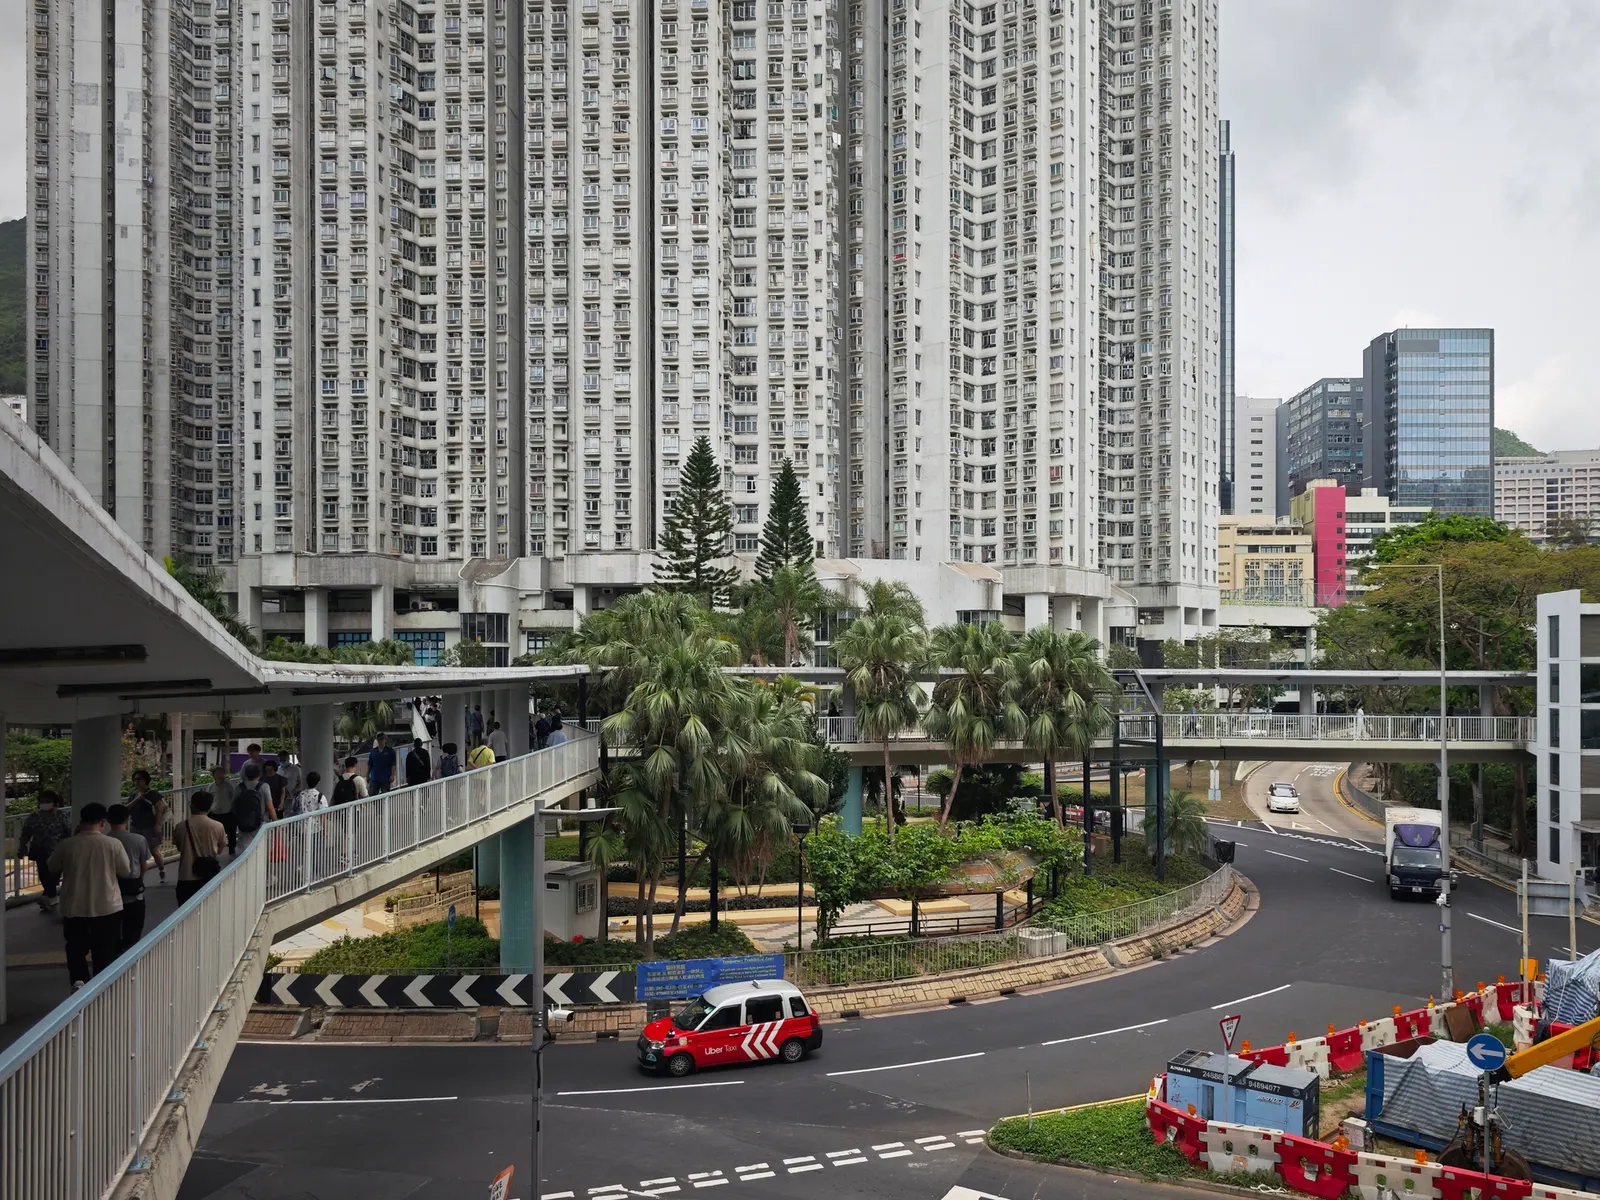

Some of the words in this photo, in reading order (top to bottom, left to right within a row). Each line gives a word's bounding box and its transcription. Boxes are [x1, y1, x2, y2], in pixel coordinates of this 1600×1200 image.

[705, 1046, 723, 1055] Uber
[1170, 1065, 1191, 1073] AIRMAN
[1248, 1081, 1280, 1092] 94894077
